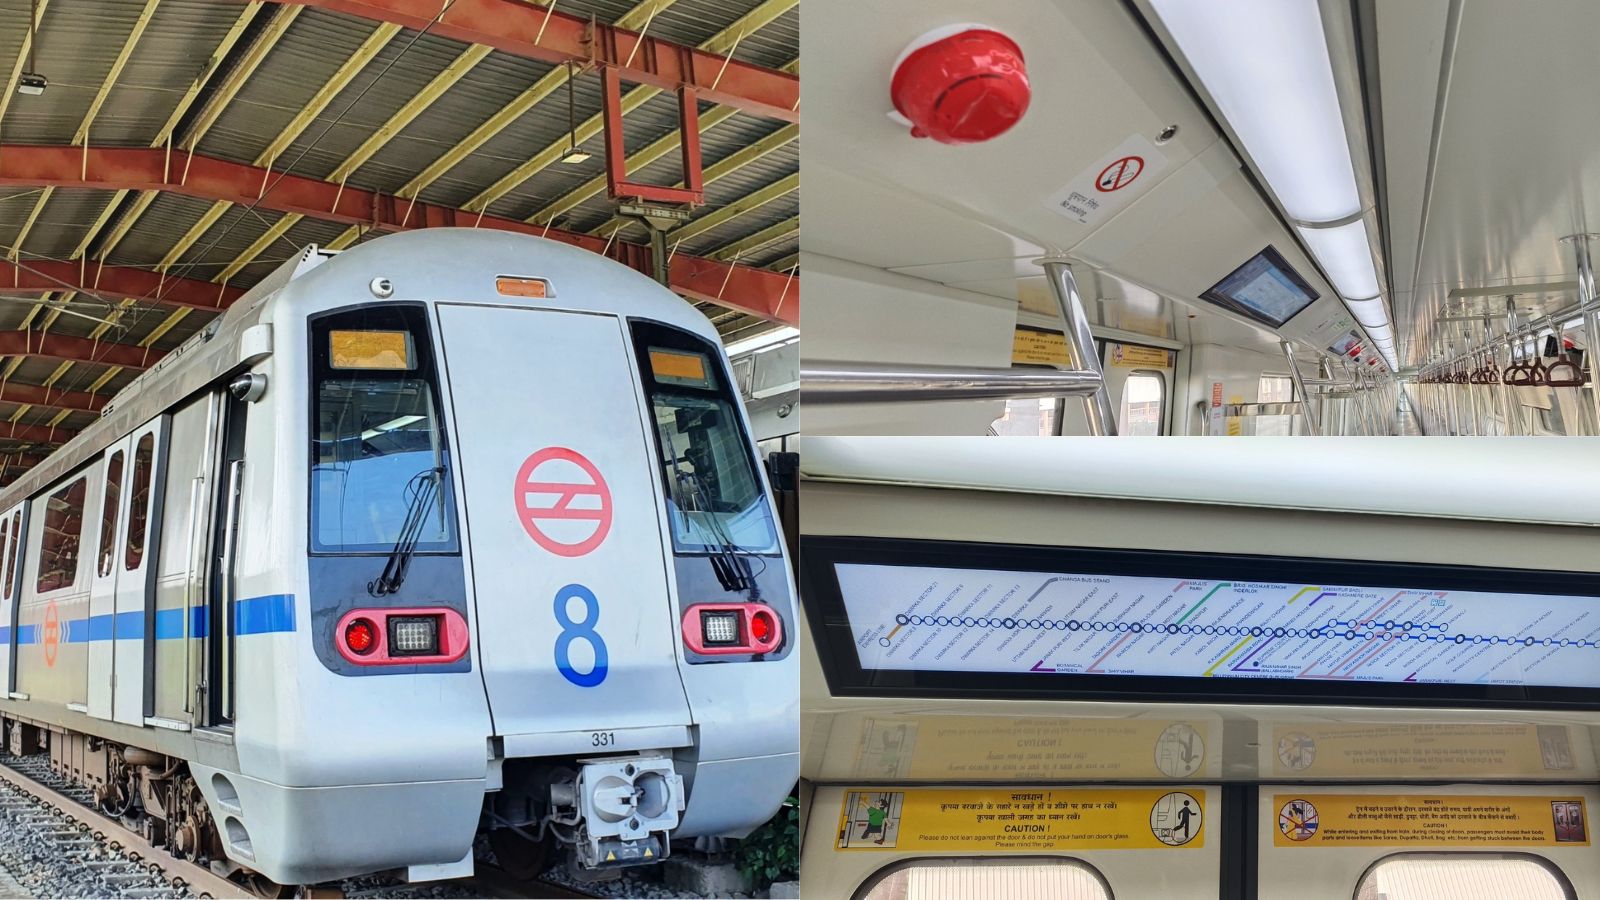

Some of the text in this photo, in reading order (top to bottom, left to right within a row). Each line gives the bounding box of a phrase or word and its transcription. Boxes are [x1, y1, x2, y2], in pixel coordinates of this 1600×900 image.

[554, 584, 608, 688] 8
[592, 732, 615, 746] 331
[1048, 792, 1052, 800] !
[1004, 824, 1050, 832] CAUTION !
